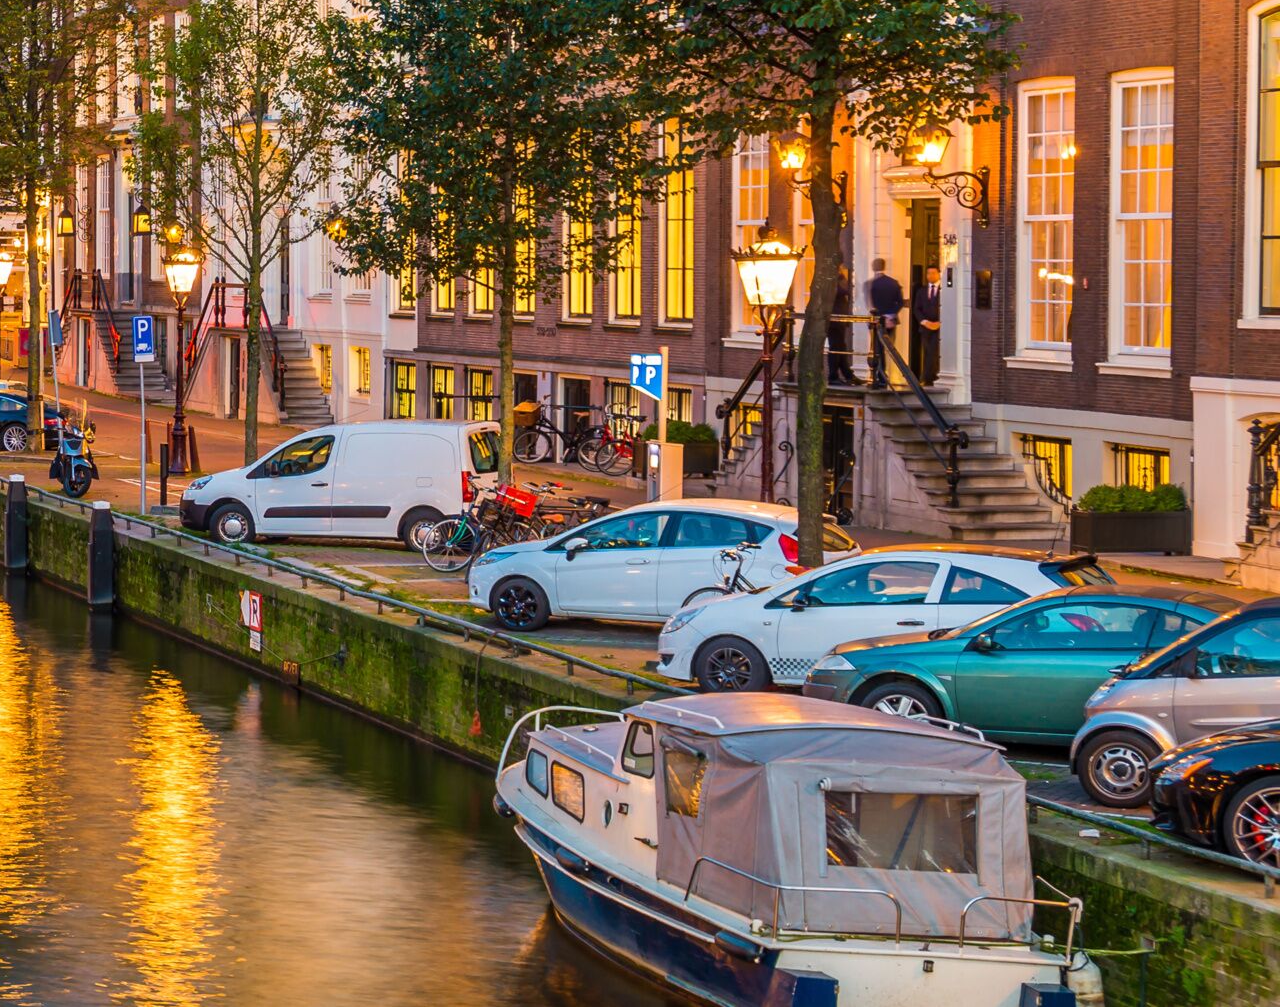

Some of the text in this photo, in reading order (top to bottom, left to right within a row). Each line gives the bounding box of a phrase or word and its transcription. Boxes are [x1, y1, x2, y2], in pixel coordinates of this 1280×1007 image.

[138, 319, 149, 339] P
[632, 366, 640, 384] P
[645, 366, 657, 385] P
